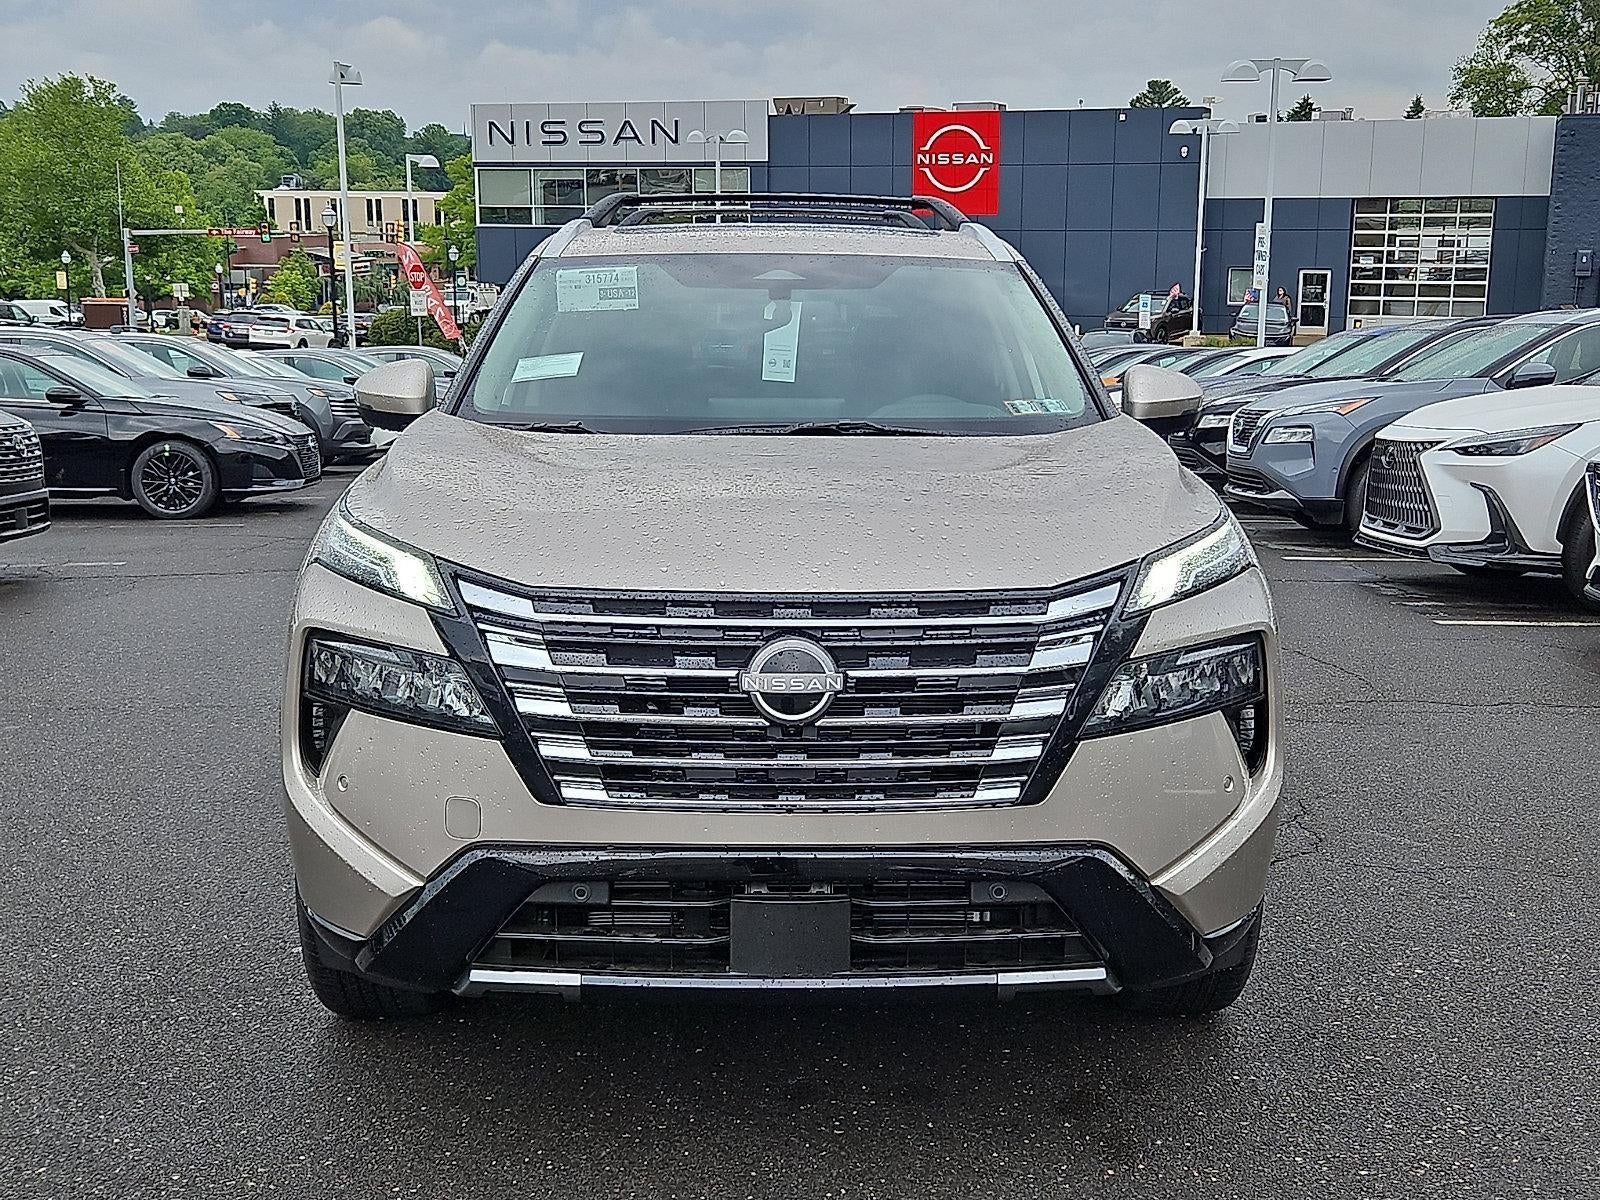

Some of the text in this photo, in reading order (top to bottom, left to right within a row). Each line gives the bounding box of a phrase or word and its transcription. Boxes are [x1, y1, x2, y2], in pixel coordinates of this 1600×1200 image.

[488, 118, 680, 146] NISSAN
[917, 153, 994, 165] NISSAN
[410, 272, 425, 282] STOP
[585, 273, 620, 285] 315774
[744, 677, 841, 691] NISSAN
